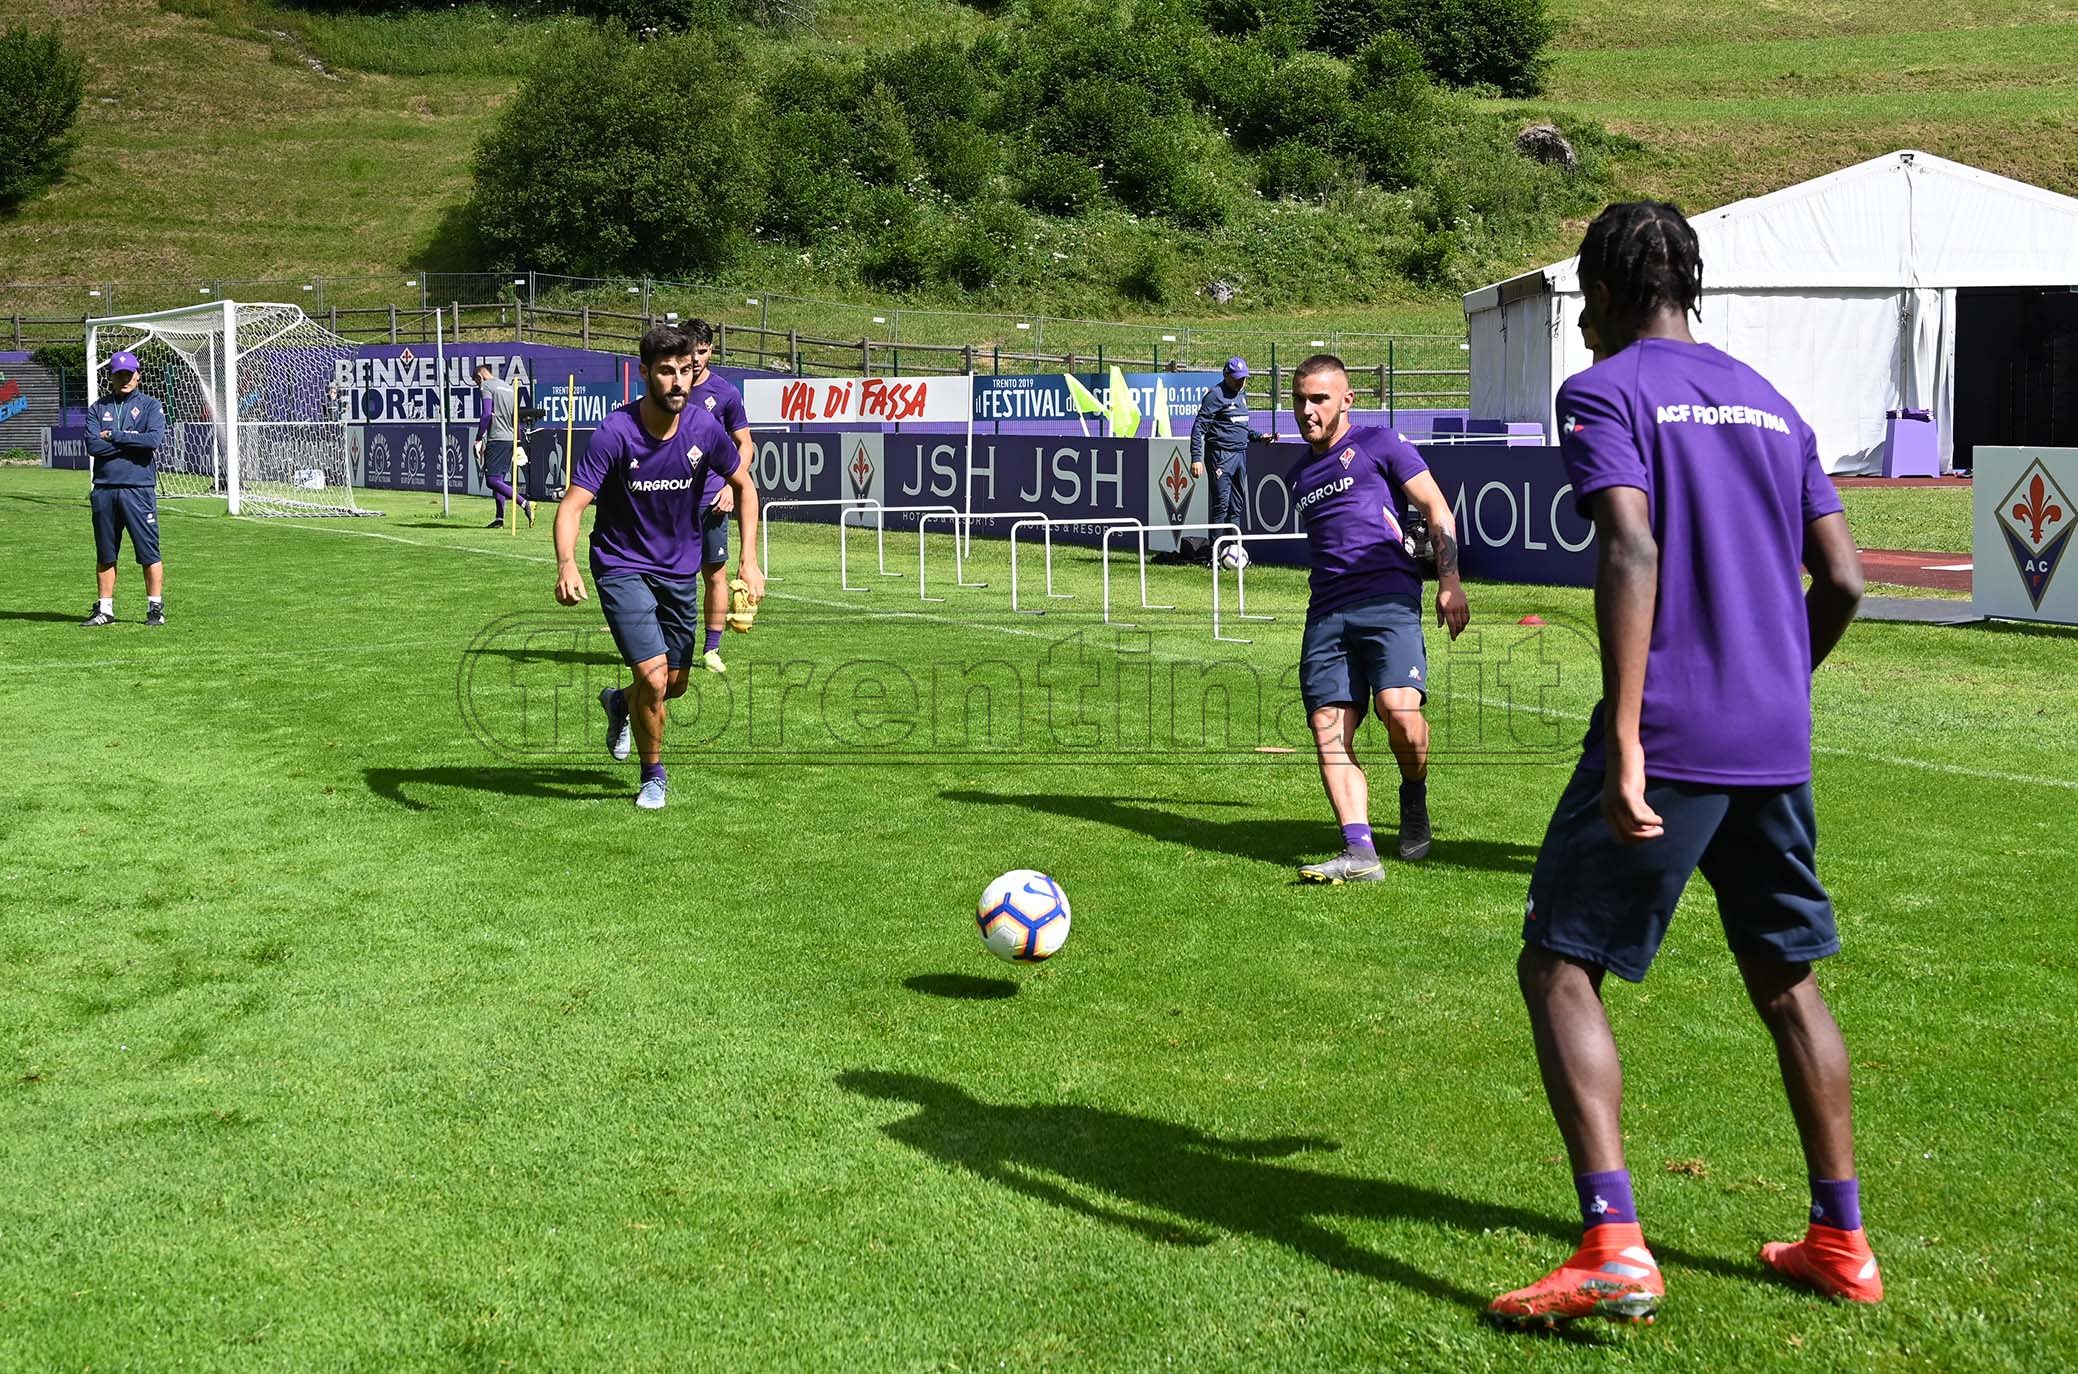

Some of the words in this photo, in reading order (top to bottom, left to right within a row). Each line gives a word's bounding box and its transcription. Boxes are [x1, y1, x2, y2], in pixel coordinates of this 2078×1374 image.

[335, 355, 531, 387] BENVENUTA
[993, 379, 1017, 388] TRENTO
[1018, 378, 1033, 388] 2019
[339, 386, 532, 420] IORENTIA
[552, 386, 570, 395] TRENT
[781, 381, 817, 421] VAL
[859, 378, 927, 421] FASSA
[982, 388, 1065, 418] FESTIVAL
[1092, 387, 1154, 416] SPRT
[543, 395, 607, 422] FESTIVAL
[1167, 404, 1202, 416] TTOBR
[1657, 404, 1691, 424] ACF
[1692, 405, 1791, 435] FIORENTINA
[748, 441, 824, 492] ROUP
[902, 444, 996, 500] JSH
[1020, 447, 1124, 508] JSH
[1297, 476, 1354, 514] ARGROUP
